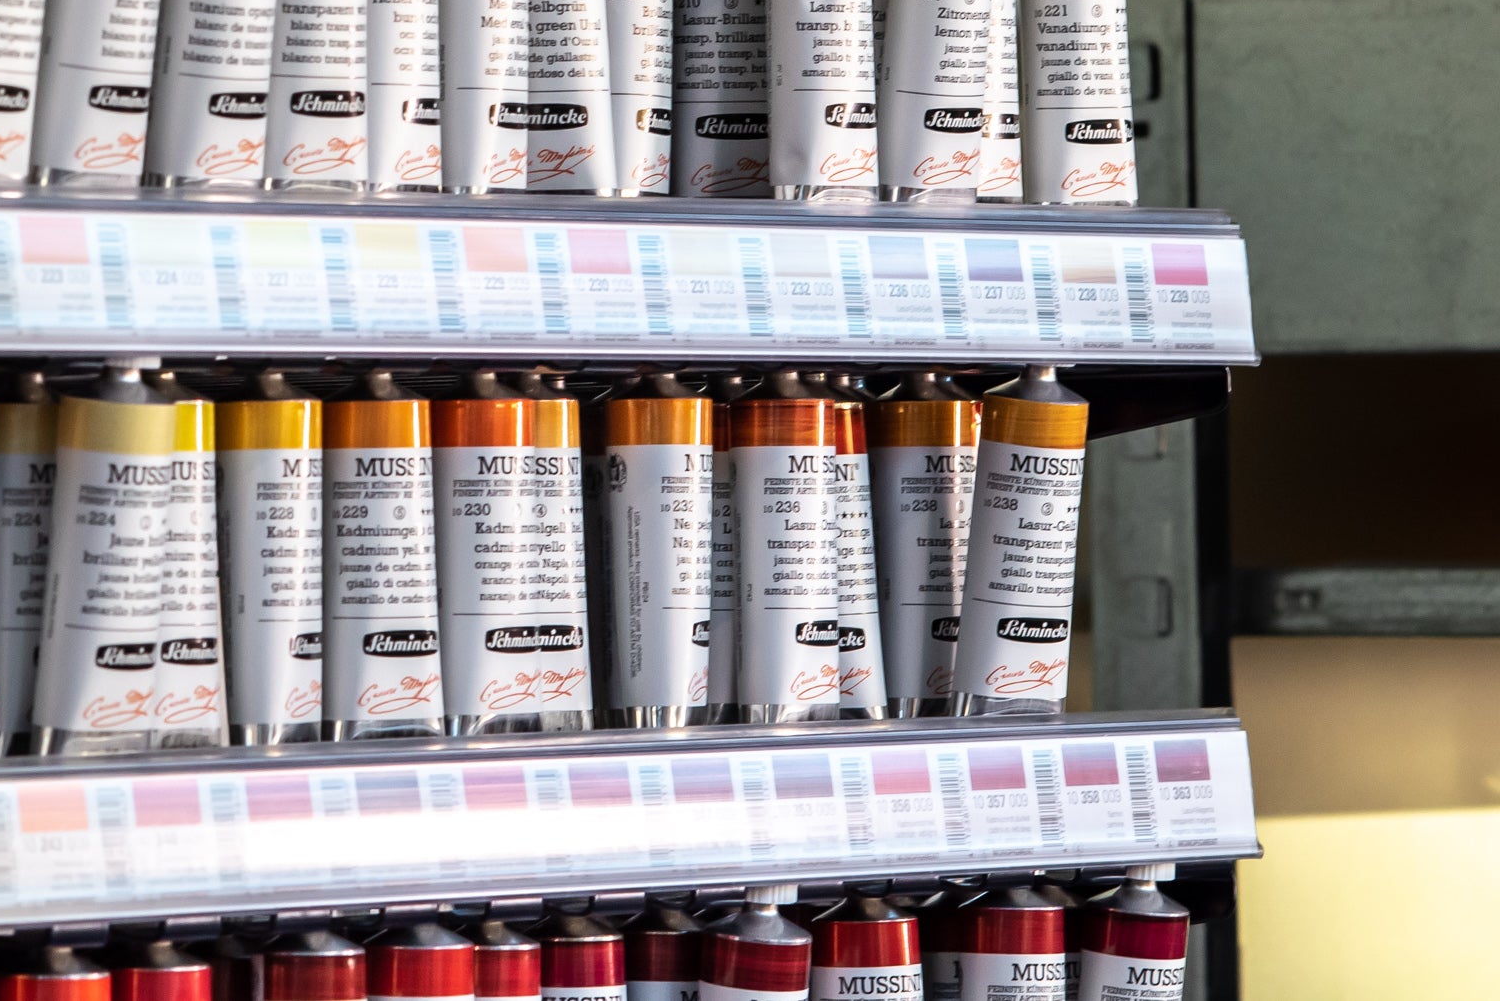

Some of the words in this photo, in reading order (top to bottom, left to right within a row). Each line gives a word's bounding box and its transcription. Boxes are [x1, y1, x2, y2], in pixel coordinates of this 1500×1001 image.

[1044, 4, 1068, 18] 221
[290, 19, 323, 33] blanc
[536, 20, 577, 34] green
[796, 21, 841, 34] transp.
[934, 25, 971, 39] lemon
[286, 36, 326, 48] bianco
[813, 37, 842, 49] jaune
[943, 43, 971, 55] jaune
[1036, 41, 1098, 53] vanadium
[282, 51, 322, 64] blanco
[684, 50, 714, 62] jaune
[813, 52, 844, 64] giallo
[1040, 56, 1071, 69] jaune
[1074, 56, 1088, 67] de
[684, 63, 716, 77] giallo
[939, 59, 967, 71] giallo
[802, 67, 847, 78] amarillo
[1047, 71, 1079, 84] giallo
[1081, 71, 1092, 81] di
[1037, 86, 1081, 97] amarillo
[1084, 86, 1096, 96] de
[41, 270, 63, 285] 223
[691, 279, 711, 295] 231
[790, 281, 811, 296] 232
[889, 282, 908, 298] 236
[984, 284, 1003, 300] 237
[1078, 286, 1097, 302] 238
[1170, 289, 1189, 304] 239
[464, 503, 492, 517] 230
[775, 501, 801, 514] 236
[911, 499, 938, 512] 238
[993, 496, 1019, 511] 238
[15, 511, 42, 527] 224
[88, 511, 116, 527] 224
[269, 506, 295, 520] 228
[341, 505, 369, 519] 229
[993, 533, 1062, 549] transparent
[342, 545, 399, 557] cadmium
[1002, 551, 1034, 565] jaune
[774, 555, 804, 567] jaune
[339, 562, 372, 575] jaune
[375, 562, 389, 572] de
[1001, 566, 1033, 580] giallo
[346, 577, 380, 590] giallo
[383, 577, 393, 588] di
[773, 570, 804, 583] giallo
[764, 586, 809, 596] amarillo
[988, 580, 1034, 594] amarillo
[341, 594, 385, 605] amarillo
[387, 594, 400, 605] de
[1081, 790, 1100, 805] 358
[1173, 786, 1191, 801] 363
[891, 798, 910, 814] 356
[987, 794, 1006, 810] 357
